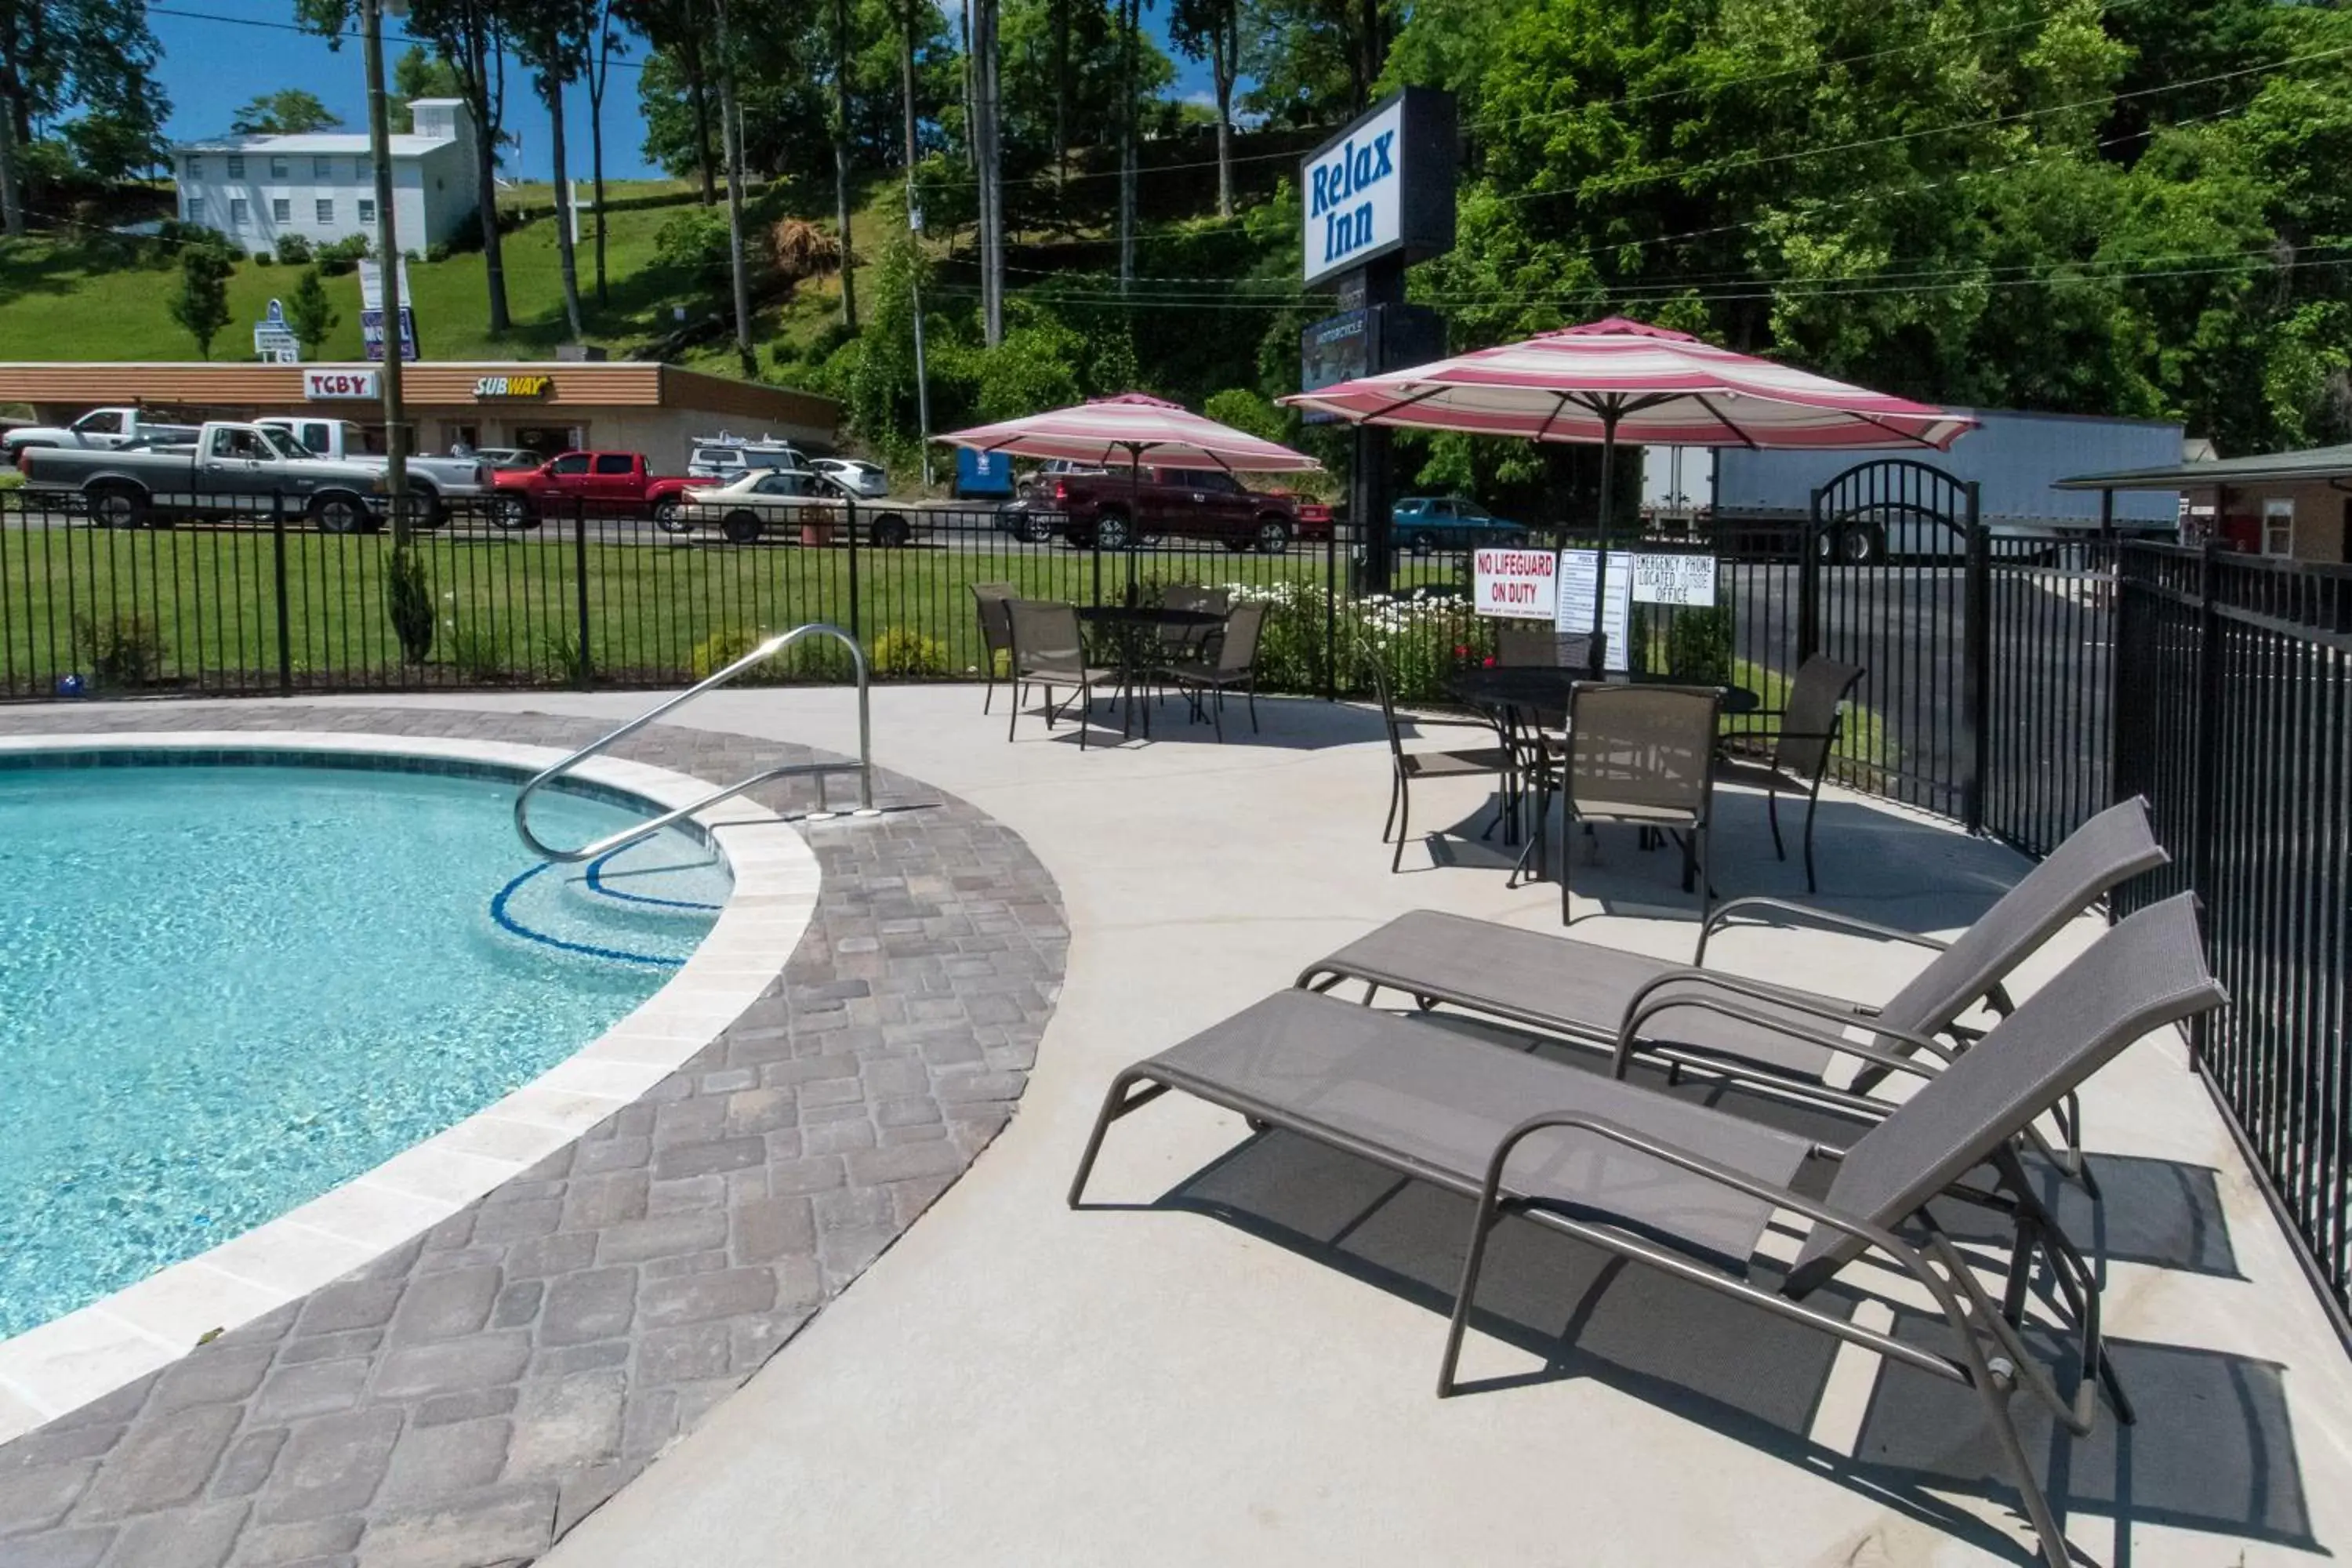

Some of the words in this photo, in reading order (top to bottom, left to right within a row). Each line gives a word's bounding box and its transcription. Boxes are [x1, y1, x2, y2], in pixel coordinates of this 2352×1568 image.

[1312, 129, 1394, 219] Relax
[1325, 201, 1372, 263] Inn
[311, 376, 365, 394] TCBY
[473, 376, 547, 395] SUBWAY
[1479, 553, 1491, 574] NO
[1495, 554, 1552, 576] LIFEGUARD
[1636, 555, 1679, 572] EMERGENCY
[1686, 557, 1711, 573] PHONE
[1638, 570, 1675, 587] LOCATED
[1492, 583, 1505, 602] ON
[1509, 583, 1537, 603] DUTY
[1656, 586, 1687, 603] OFFICE
